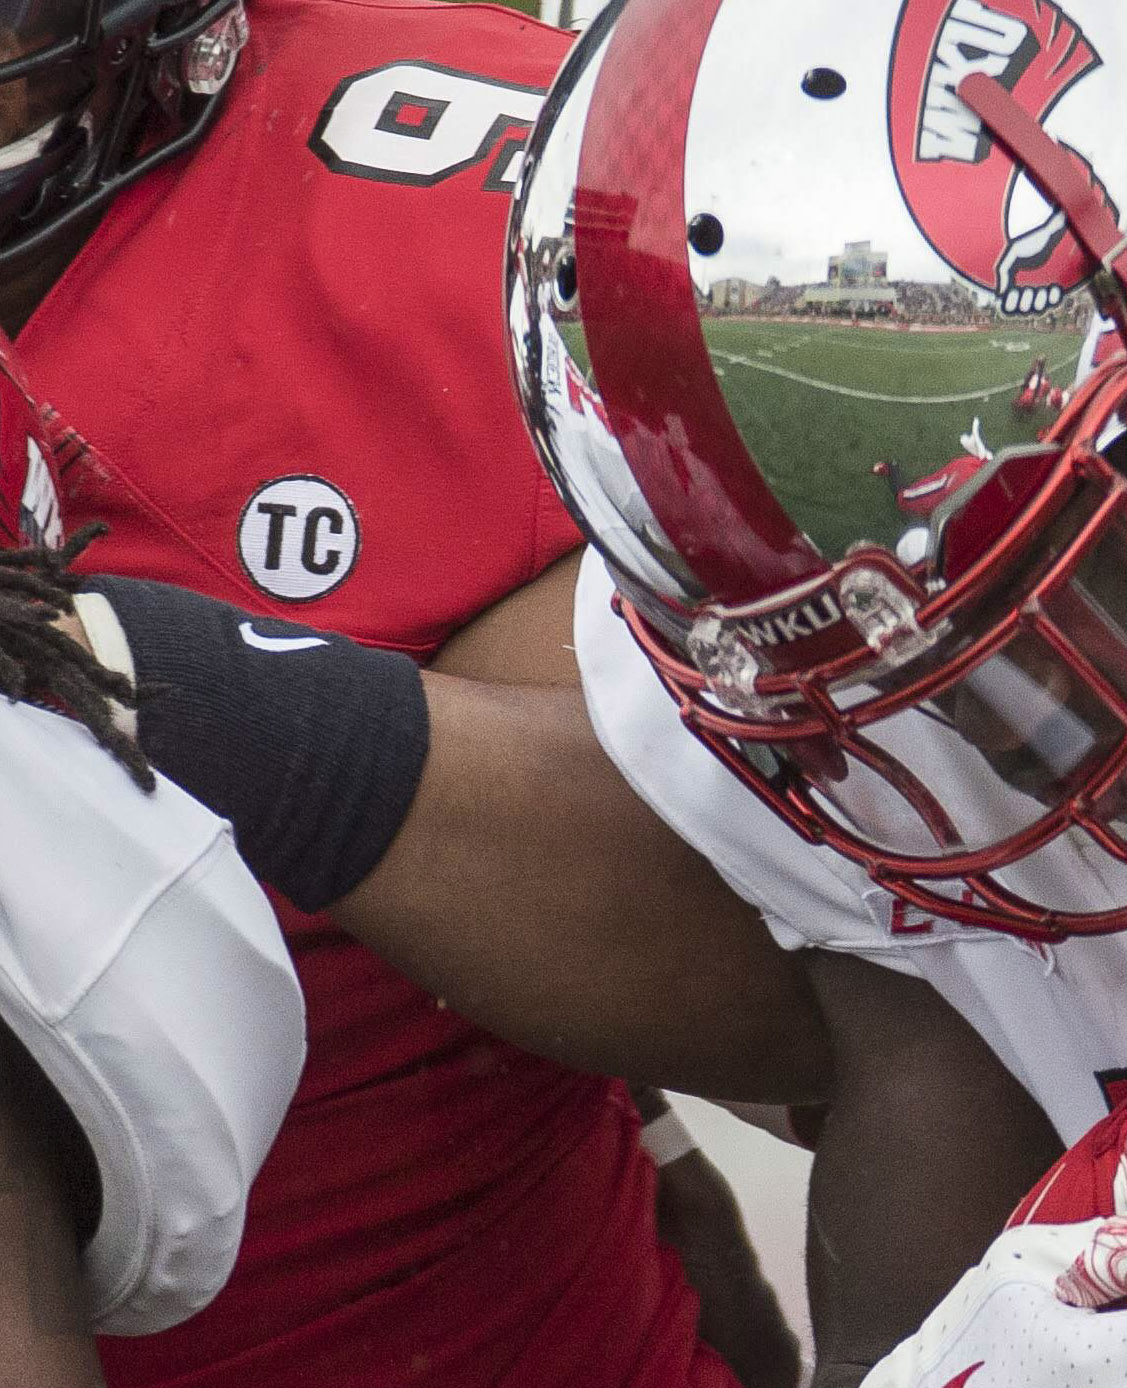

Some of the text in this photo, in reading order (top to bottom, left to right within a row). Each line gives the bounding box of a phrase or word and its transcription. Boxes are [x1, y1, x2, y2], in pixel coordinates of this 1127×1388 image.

[919, 0, 1028, 162] WKU
[257, 502, 343, 575] TC
[736, 592, 841, 647] WKU
